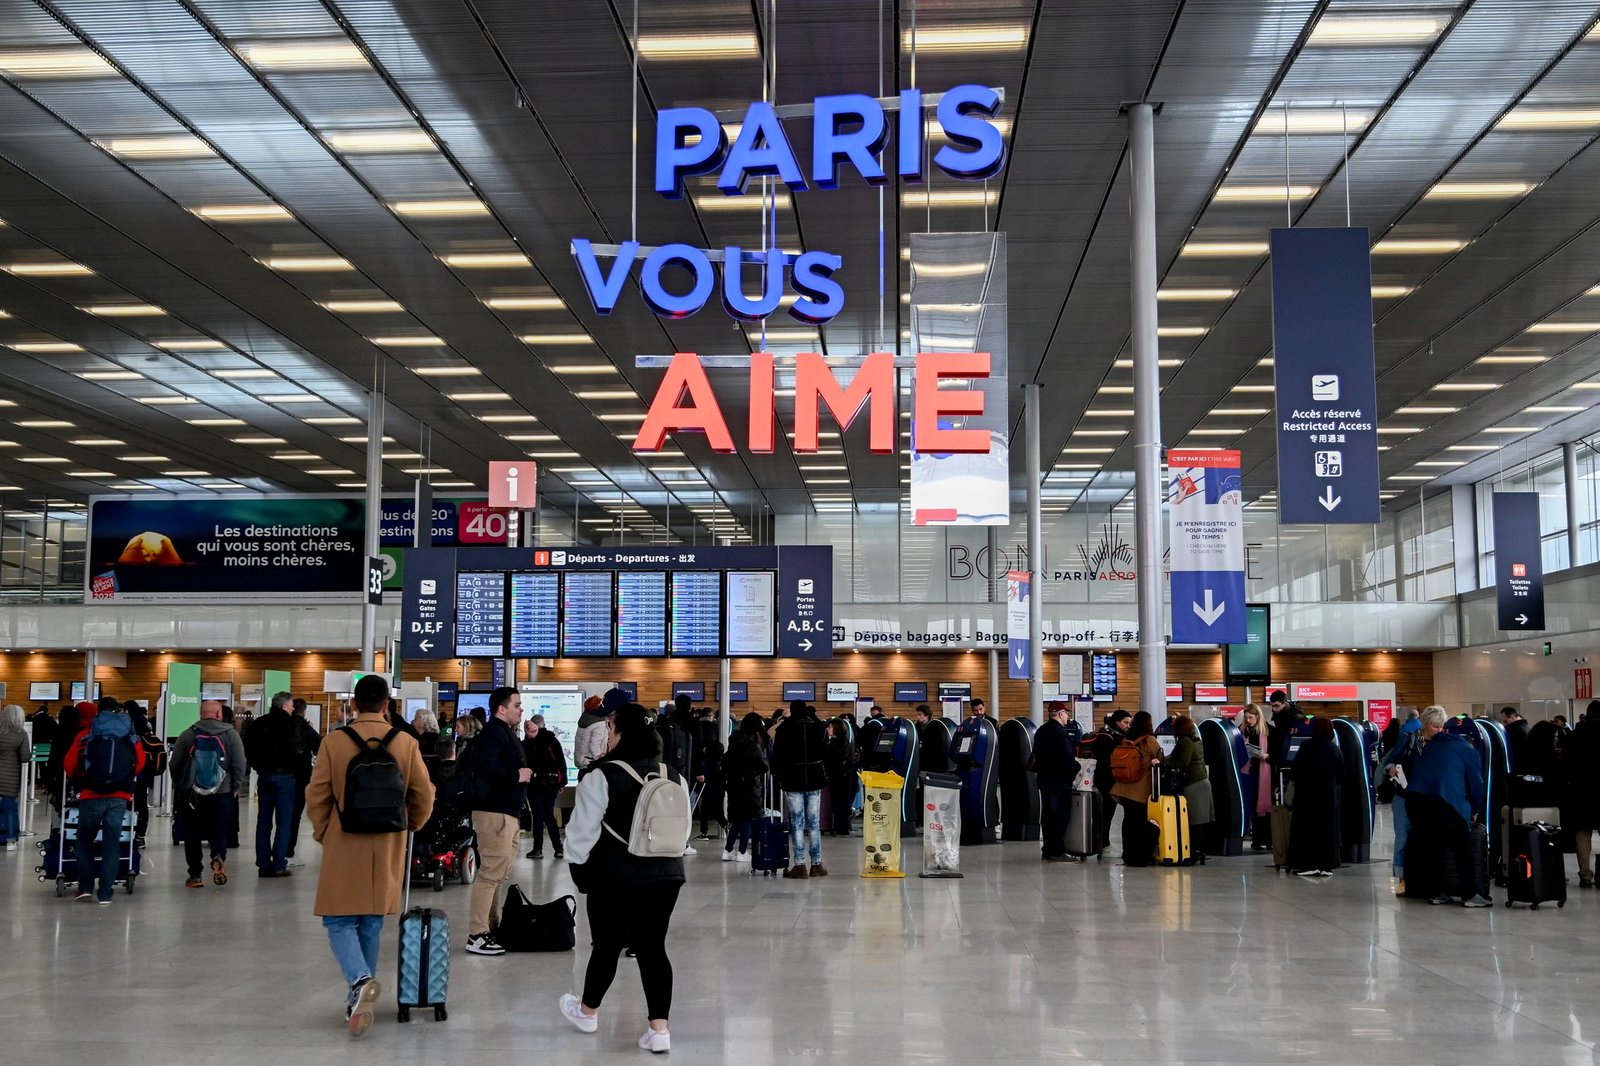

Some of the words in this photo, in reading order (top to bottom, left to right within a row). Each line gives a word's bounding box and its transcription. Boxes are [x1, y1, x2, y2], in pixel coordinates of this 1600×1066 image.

[656, 85, 1006, 198] PARIS
[571, 238, 844, 324] VOUS
[632, 353, 991, 453] AIME
[1292, 409, 1321, 419] Accès
[1324, 409, 1362, 419] réservé
[1283, 421, 1335, 431] Restricted
[1338, 422, 1371, 431] Access
[381, 509, 399, 521] lus
[214, 524, 241, 537] Les
[245, 523, 338, 537] destinations
[196, 539, 221, 555] qui
[224, 541, 260, 552] vous
[264, 540, 297, 552] sont
[300, 538, 356, 553] chères,
[224, 553, 269, 567] moins
[272, 553, 327, 567] chères.
[568, 553, 607, 567] Départs
[615, 553, 670, 567] Departures
[370, 568, 382, 595] 33
[411, 621, 443, 635] D,E,F
[787, 620, 825, 633] A,B,C
[854, 630, 902, 645] Dépose
[907, 630, 962, 645] bagages
[976, 631, 1008, 645] Bagg
